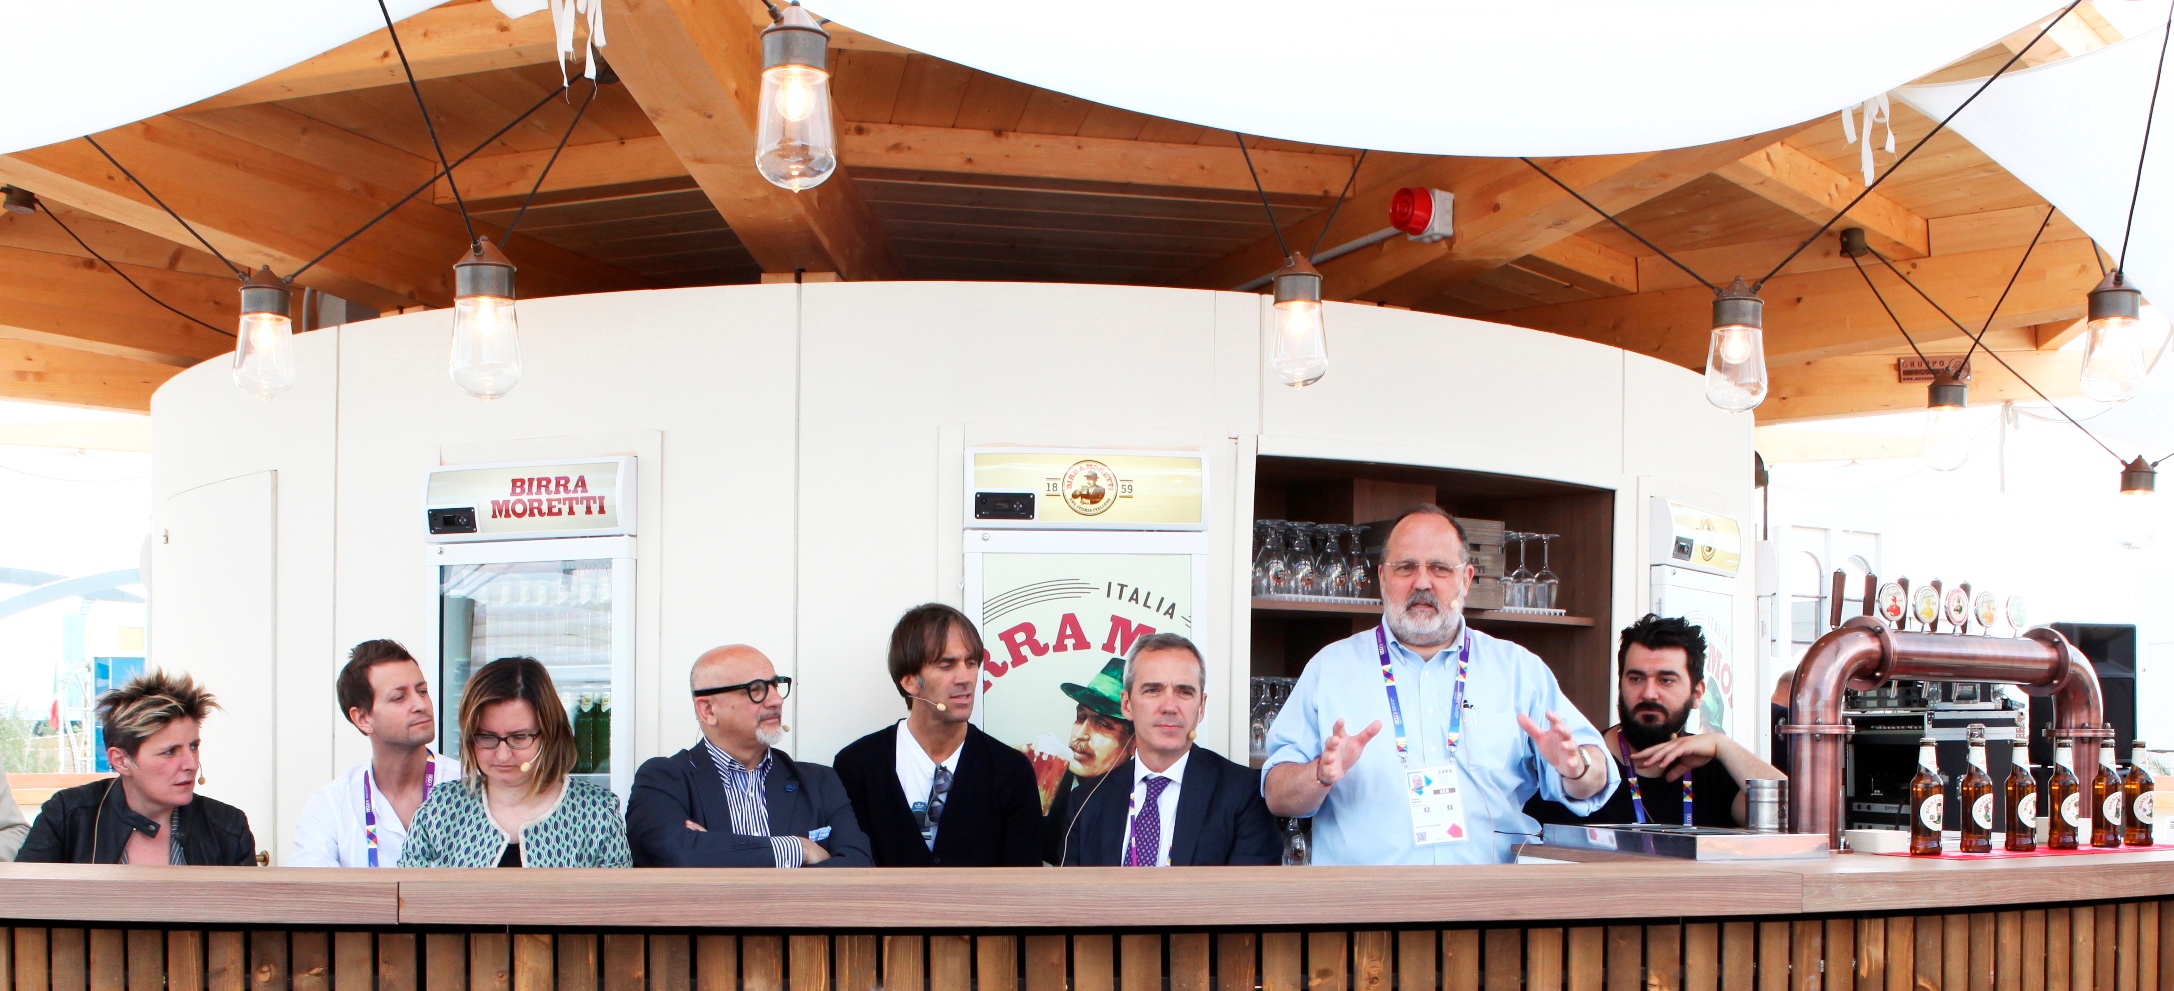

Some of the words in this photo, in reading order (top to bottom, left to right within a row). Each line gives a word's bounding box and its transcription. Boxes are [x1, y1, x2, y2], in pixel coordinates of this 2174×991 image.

[510, 475, 588, 496] BIRRA
[1046, 483, 1058, 492] 18
[1066, 465, 1085, 489] BIRRA
[1085, 463, 1114, 491] MORETTI
[1121, 485, 1133, 494] 59
[491, 495, 606, 519] MORETTI
[1106, 581, 1177, 620] ITALIA
[1707, 614, 1729, 645] ITALIA
